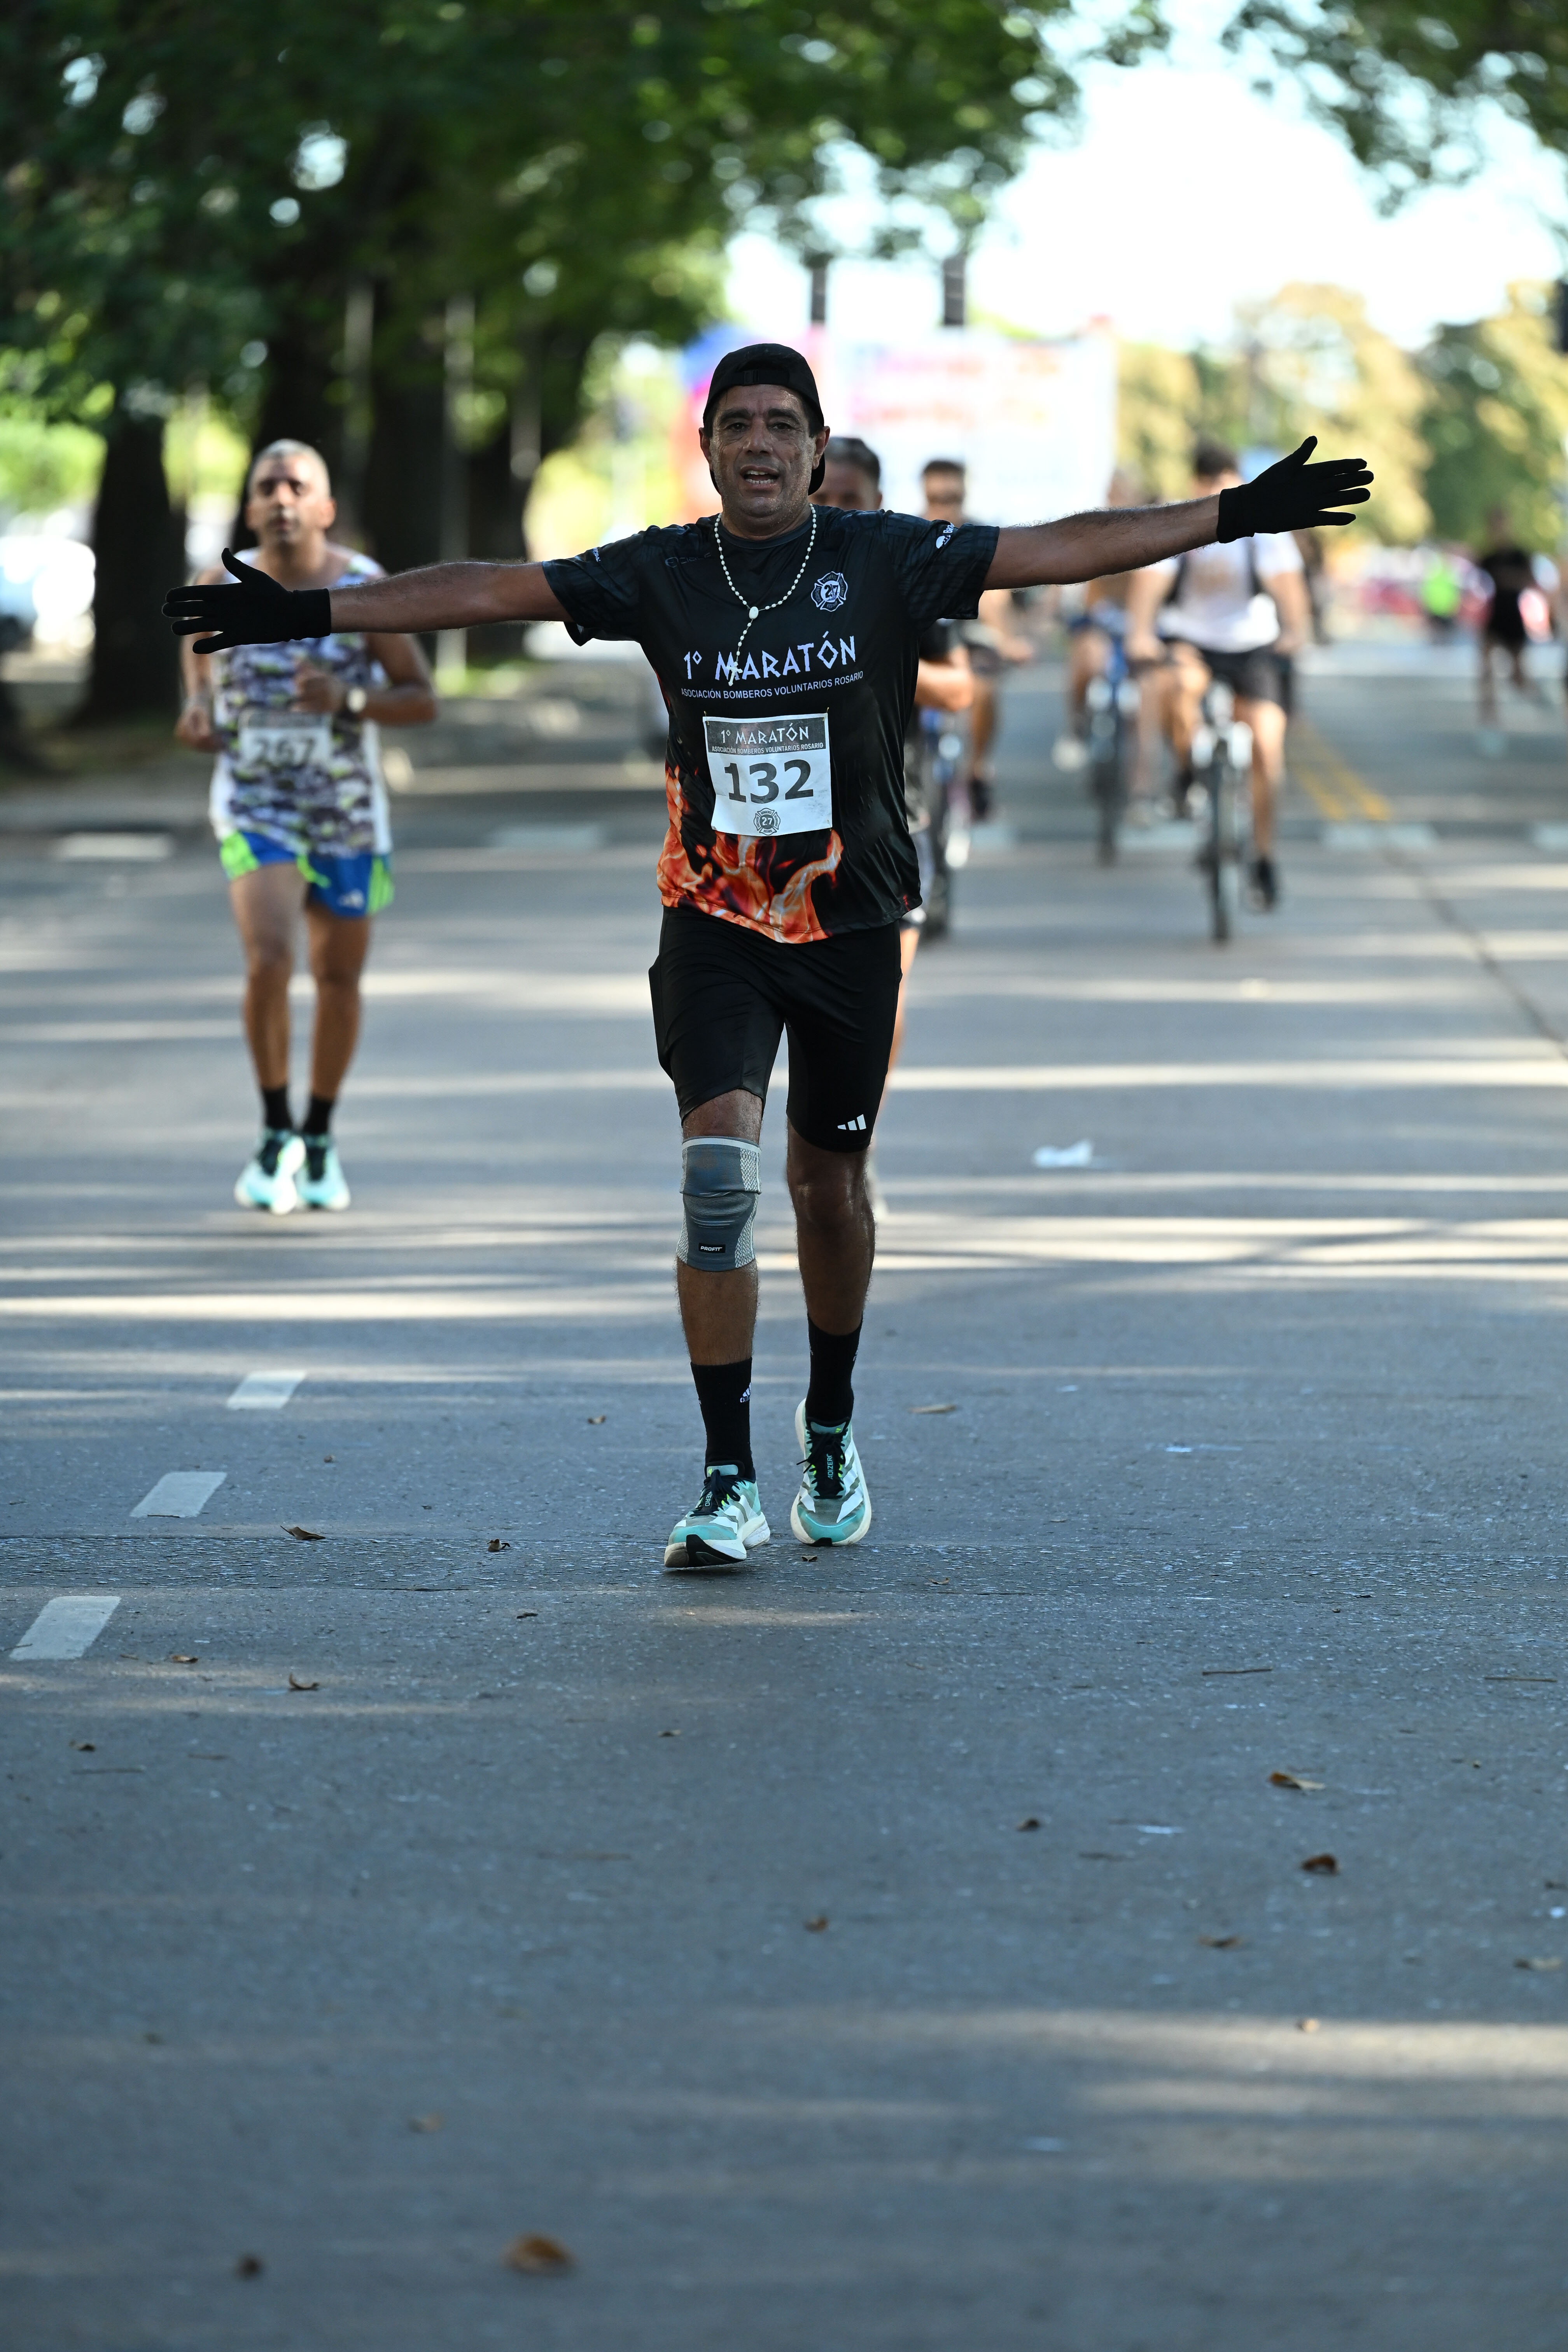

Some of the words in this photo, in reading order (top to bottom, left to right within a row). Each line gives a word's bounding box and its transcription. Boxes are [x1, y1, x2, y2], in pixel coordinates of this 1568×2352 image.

[824, 584, 839, 598] 27
[715, 630, 856, 681] MARATÓN
[681, 688, 721, 699] ASOCIACIÓN
[723, 688, 772, 699] BOMBEROS
[774, 679, 833, 696] VOLUNTARIOS
[835, 670, 863, 686] ROSARIO
[735, 722, 809, 745] MARATÓN
[765, 744, 800, 753] VOLUNTARIOS
[801, 742, 824, 750] ROSARIO
[724, 759, 814, 804] 132
[761, 817, 773, 826] 27
